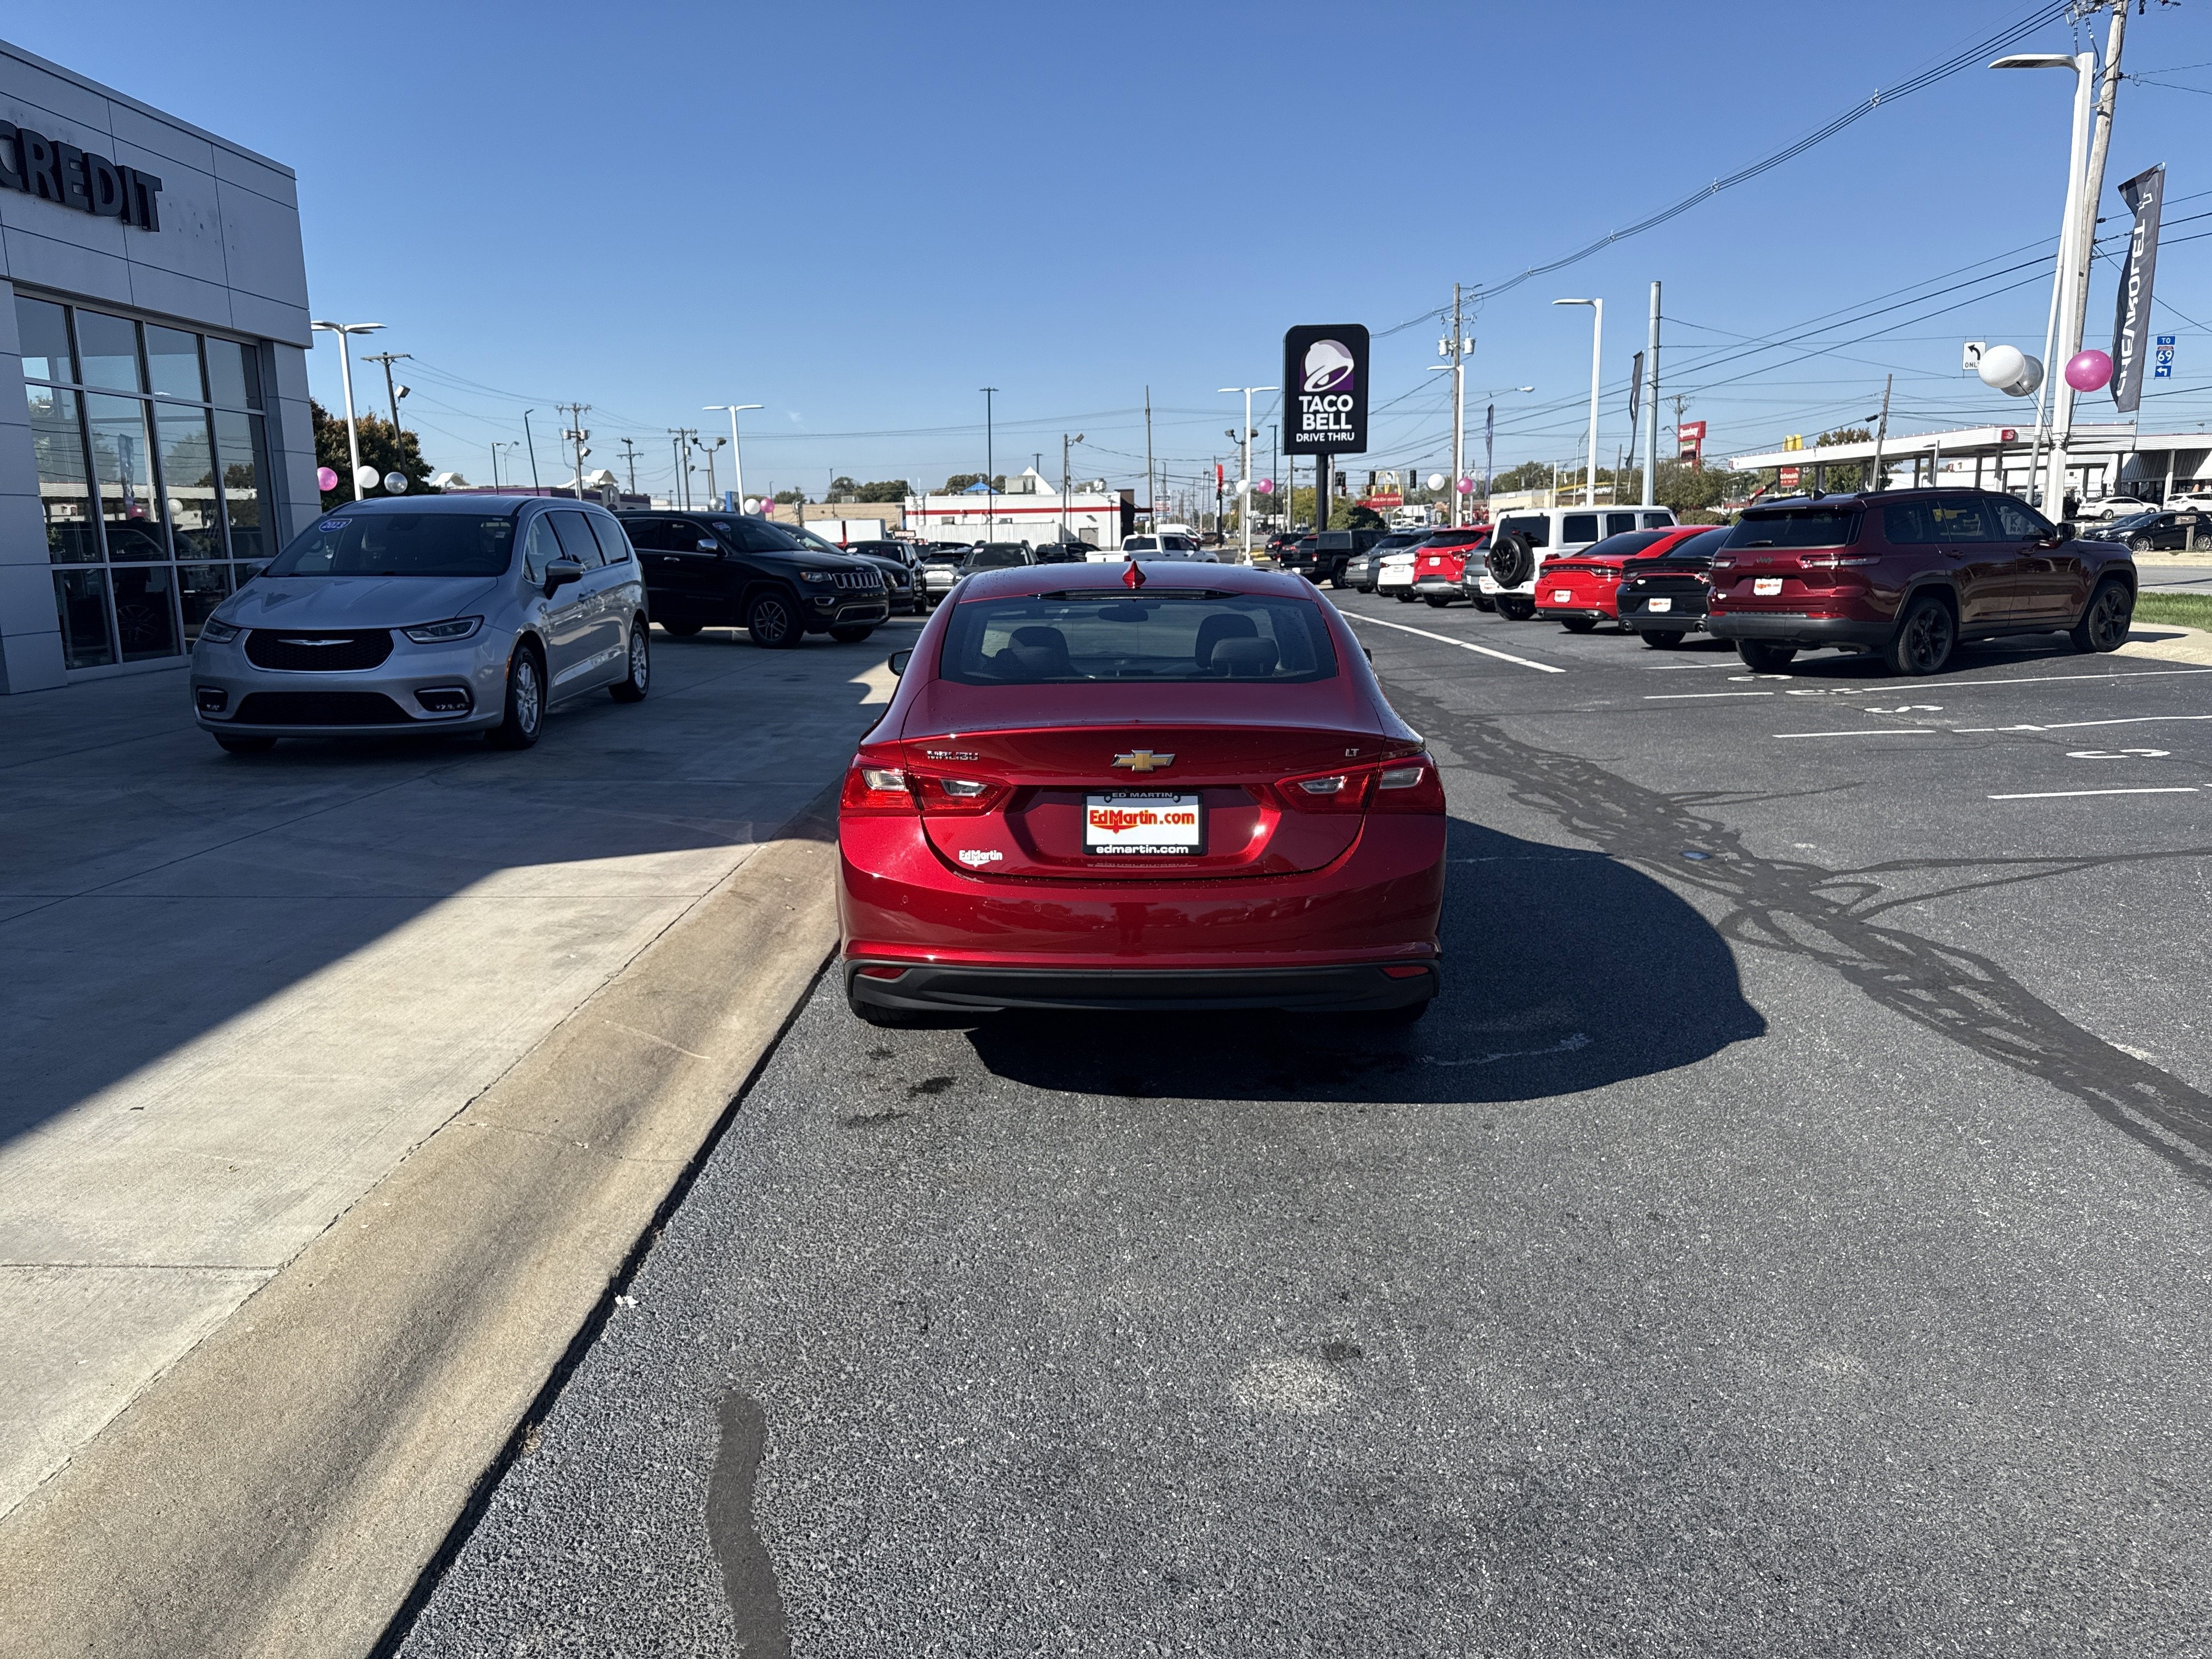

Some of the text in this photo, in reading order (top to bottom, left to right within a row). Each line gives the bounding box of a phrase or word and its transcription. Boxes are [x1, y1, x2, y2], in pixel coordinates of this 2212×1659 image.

[0, 120, 162, 232] CREDIT
[2158, 351, 2172, 361] 69
[1299, 395, 1353, 412] TACO
[1302, 413, 1352, 430] BELL
[1296, 432, 1355, 442] DRIVE THRU
[927, 750, 979, 761] MALIBU
[1345, 748, 1359, 757] LT
[1090, 809, 1195, 831] EdMartin.com
[1096, 844, 1189, 854] edmartin.com
[958, 849, 1003, 865] EdMartin
